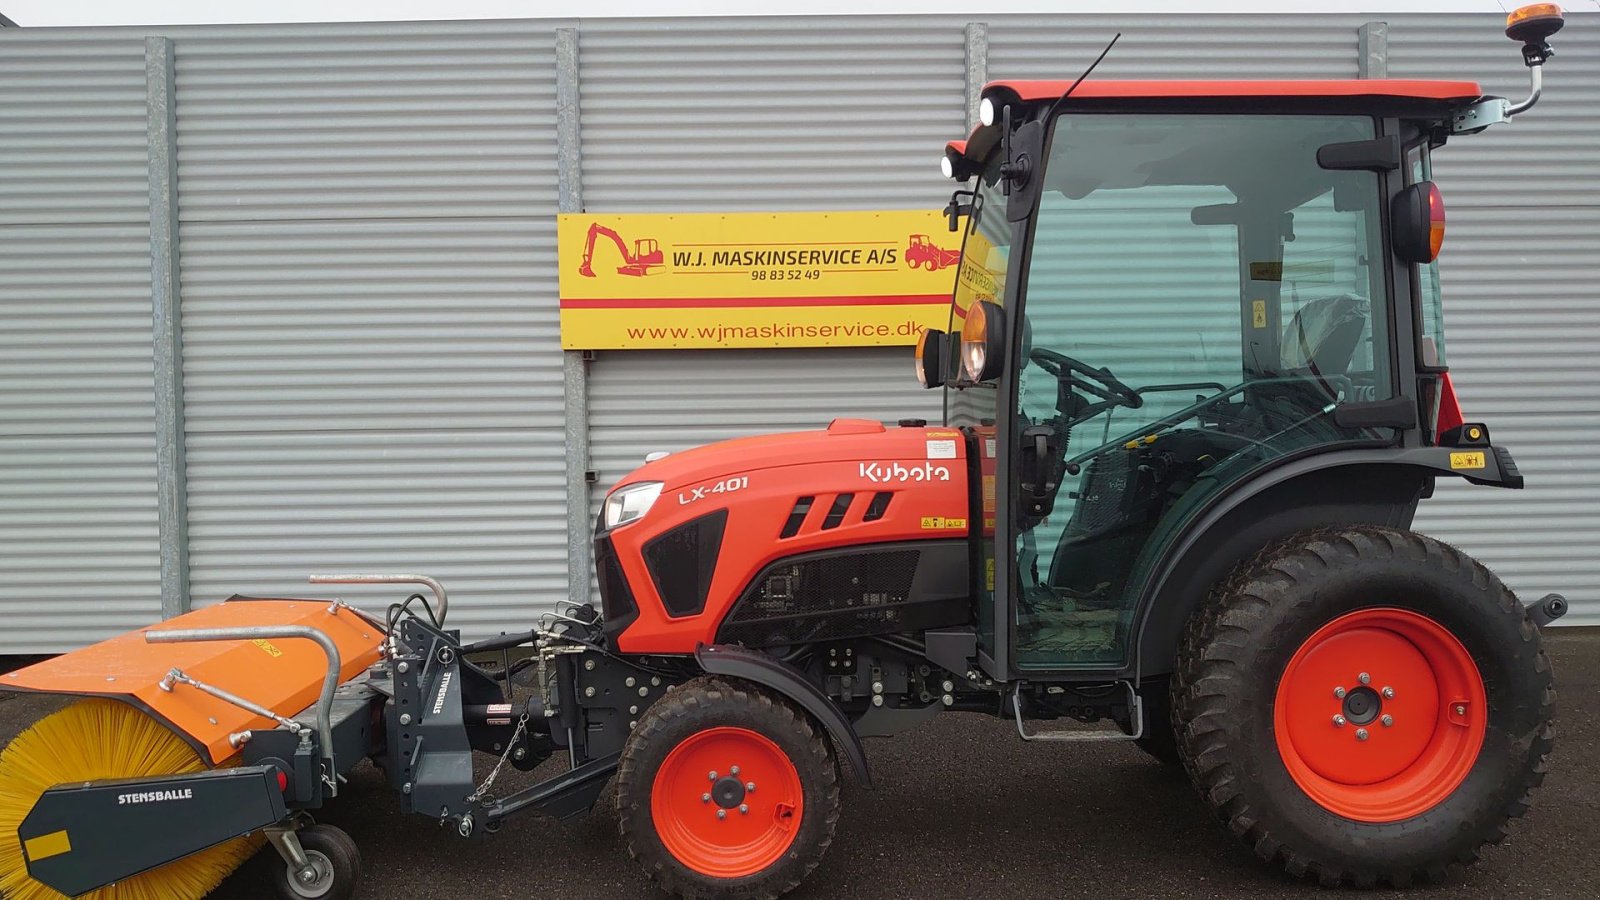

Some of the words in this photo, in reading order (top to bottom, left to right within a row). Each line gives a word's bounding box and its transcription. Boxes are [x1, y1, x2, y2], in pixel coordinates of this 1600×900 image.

[673, 251, 707, 267] W.J.
[712, 249, 862, 267] MASKINSERVICE
[867, 248, 897, 265] A/S
[751, 270, 766, 281] 98
[769, 270, 784, 281] 83
[788, 270, 802, 280] 52
[805, 269, 820, 280] 49
[627, 321, 925, 342] www.wjmaskinservice.dk
[859, 461, 950, 482] Kubota
[678, 476, 748, 505] LX-401
[433, 671, 452, 714] STENSBALLE
[118, 788, 193, 805] STENSBALLE
